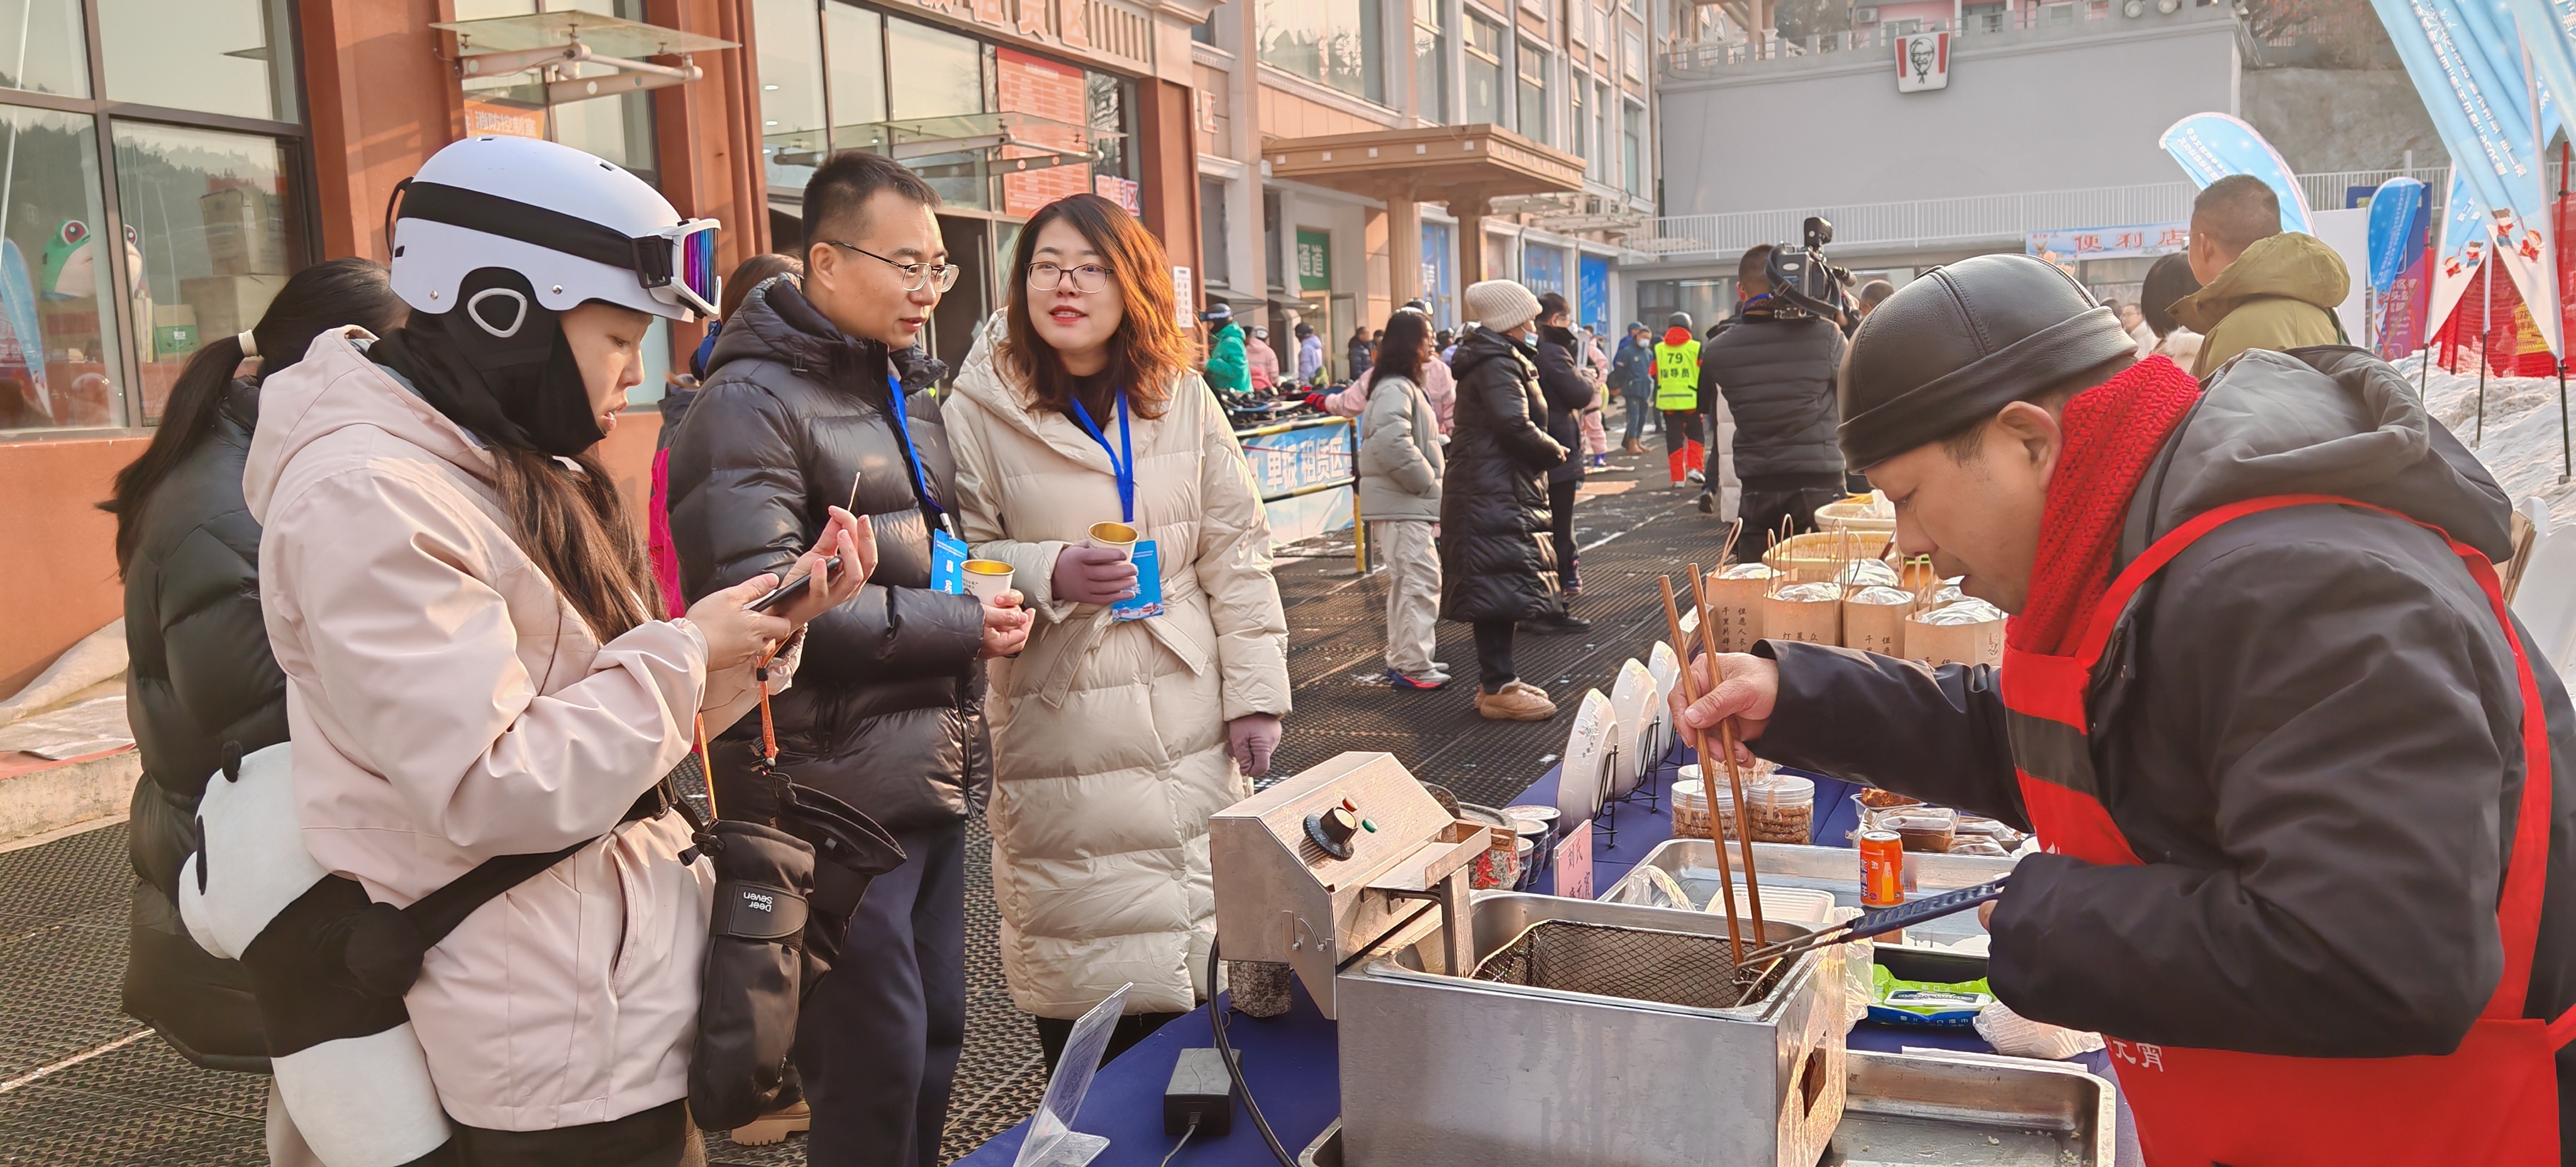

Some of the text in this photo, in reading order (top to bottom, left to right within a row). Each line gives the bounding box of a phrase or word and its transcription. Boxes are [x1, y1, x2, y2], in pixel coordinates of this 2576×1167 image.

[474, 110, 537, 136] 消防控制室
[2074, 229, 2188, 252] 便利店
[1299, 243, 1324, 277] 通道
[1667, 353, 1683, 364] 79
[1660, 368, 1690, 379] 指导员
[1738, 607, 1747, 652] 但愿人长
[743, 892, 773, 904] Seven
[748, 901, 772, 912] Deer
